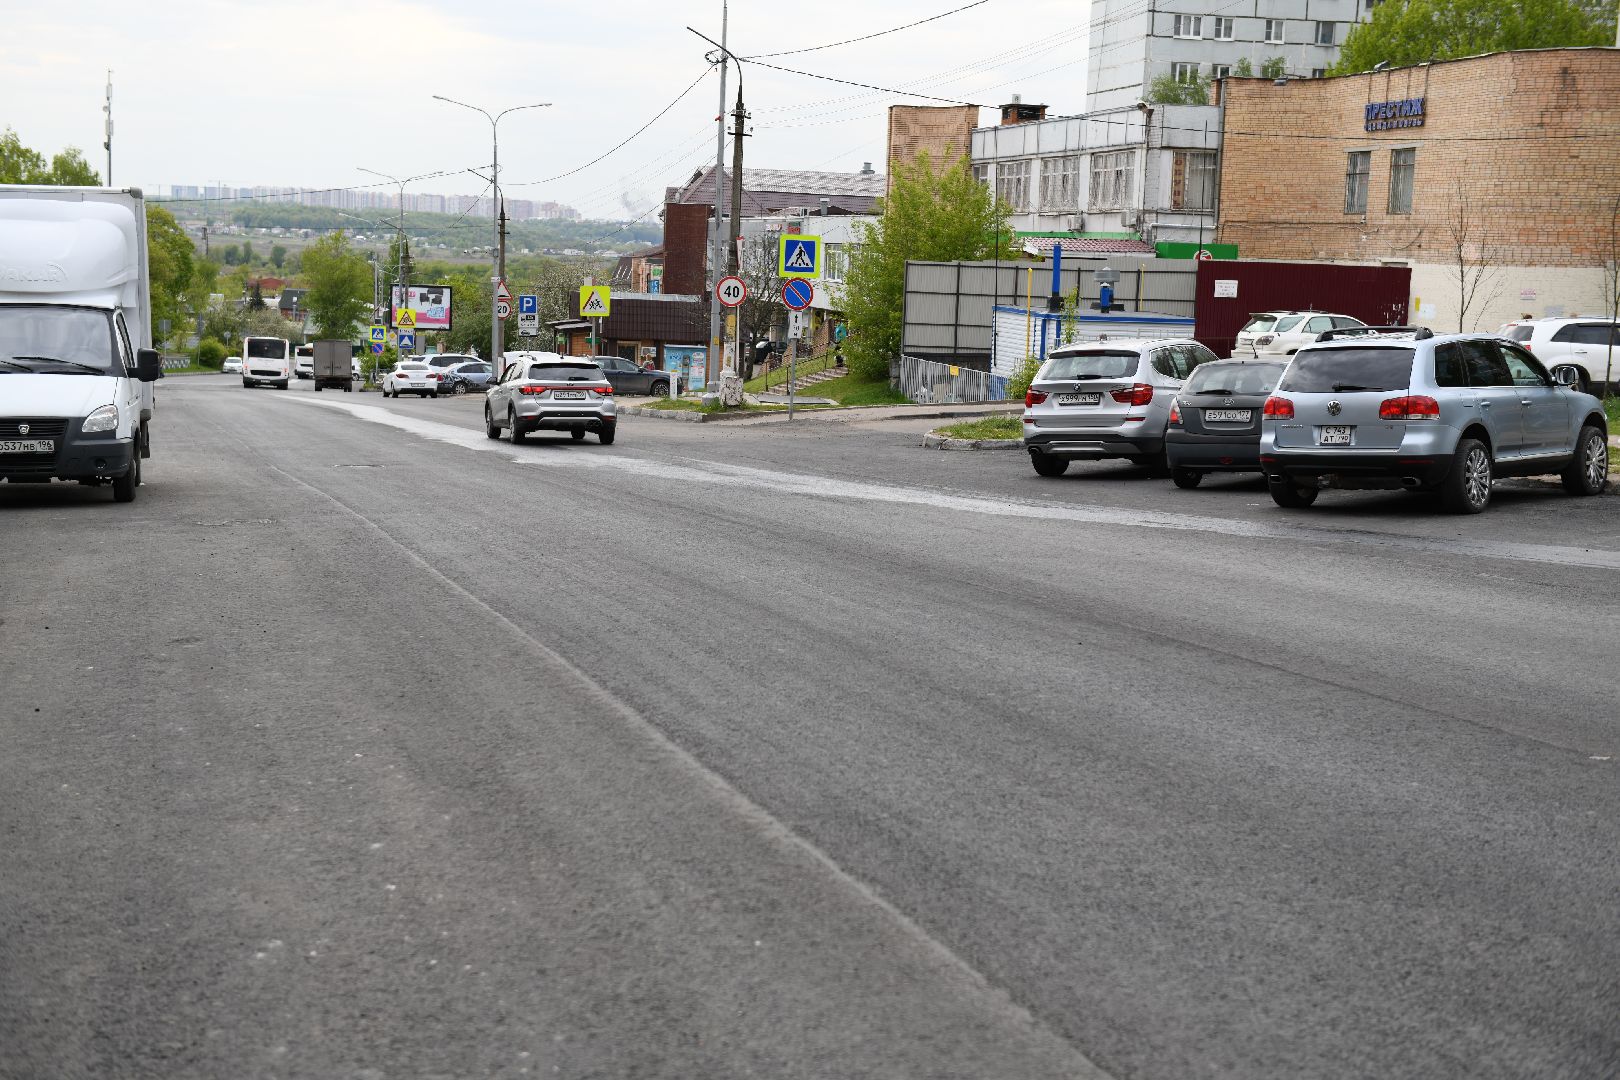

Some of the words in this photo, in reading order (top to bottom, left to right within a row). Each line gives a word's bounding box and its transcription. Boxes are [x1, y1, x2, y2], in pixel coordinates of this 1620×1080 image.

[1365, 98, 1424, 120] ПРЕСТИЖ
[724, 286, 739, 297] 40
[523, 298, 532, 311] P
[1323, 435, 1334, 443] АТ
